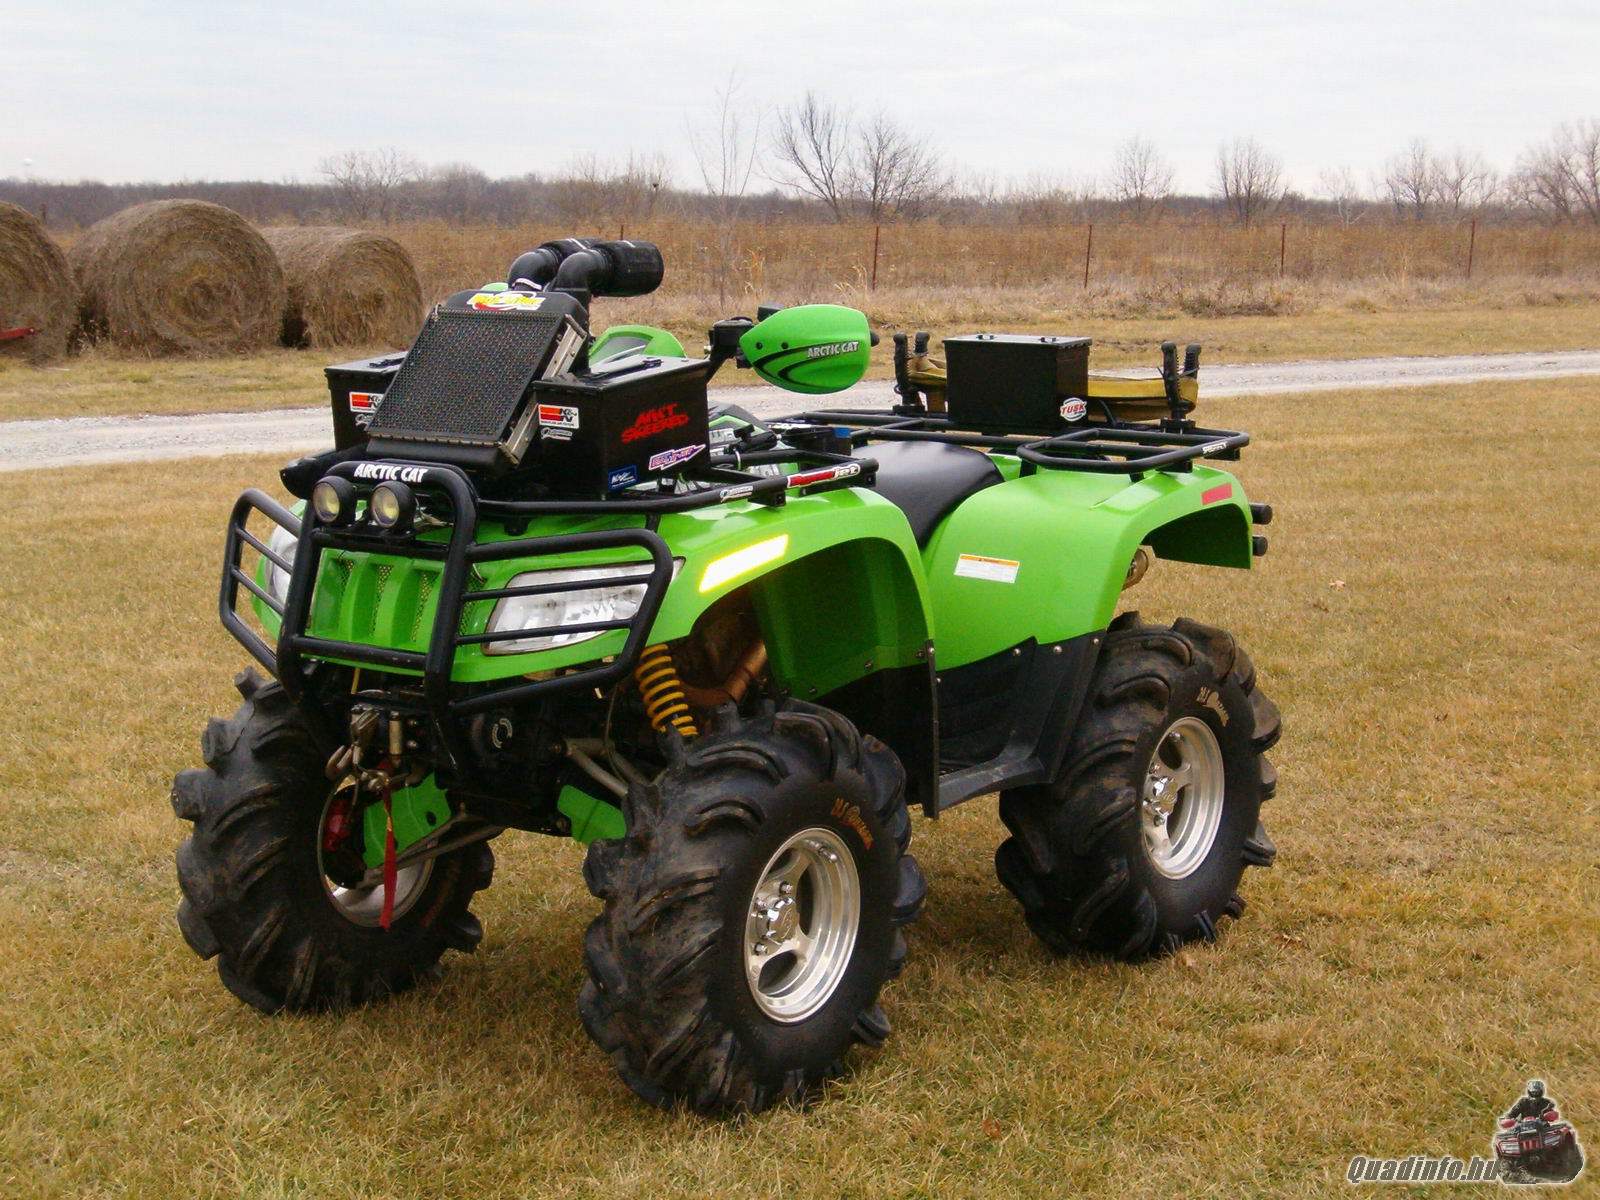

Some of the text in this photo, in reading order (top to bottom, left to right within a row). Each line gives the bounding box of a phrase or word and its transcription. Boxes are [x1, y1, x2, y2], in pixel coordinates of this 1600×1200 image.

[807, 341, 859, 358] ARCTIC CAT
[1060, 404, 1085, 415] TUSK
[353, 463, 429, 483] ARCTIC CAT
